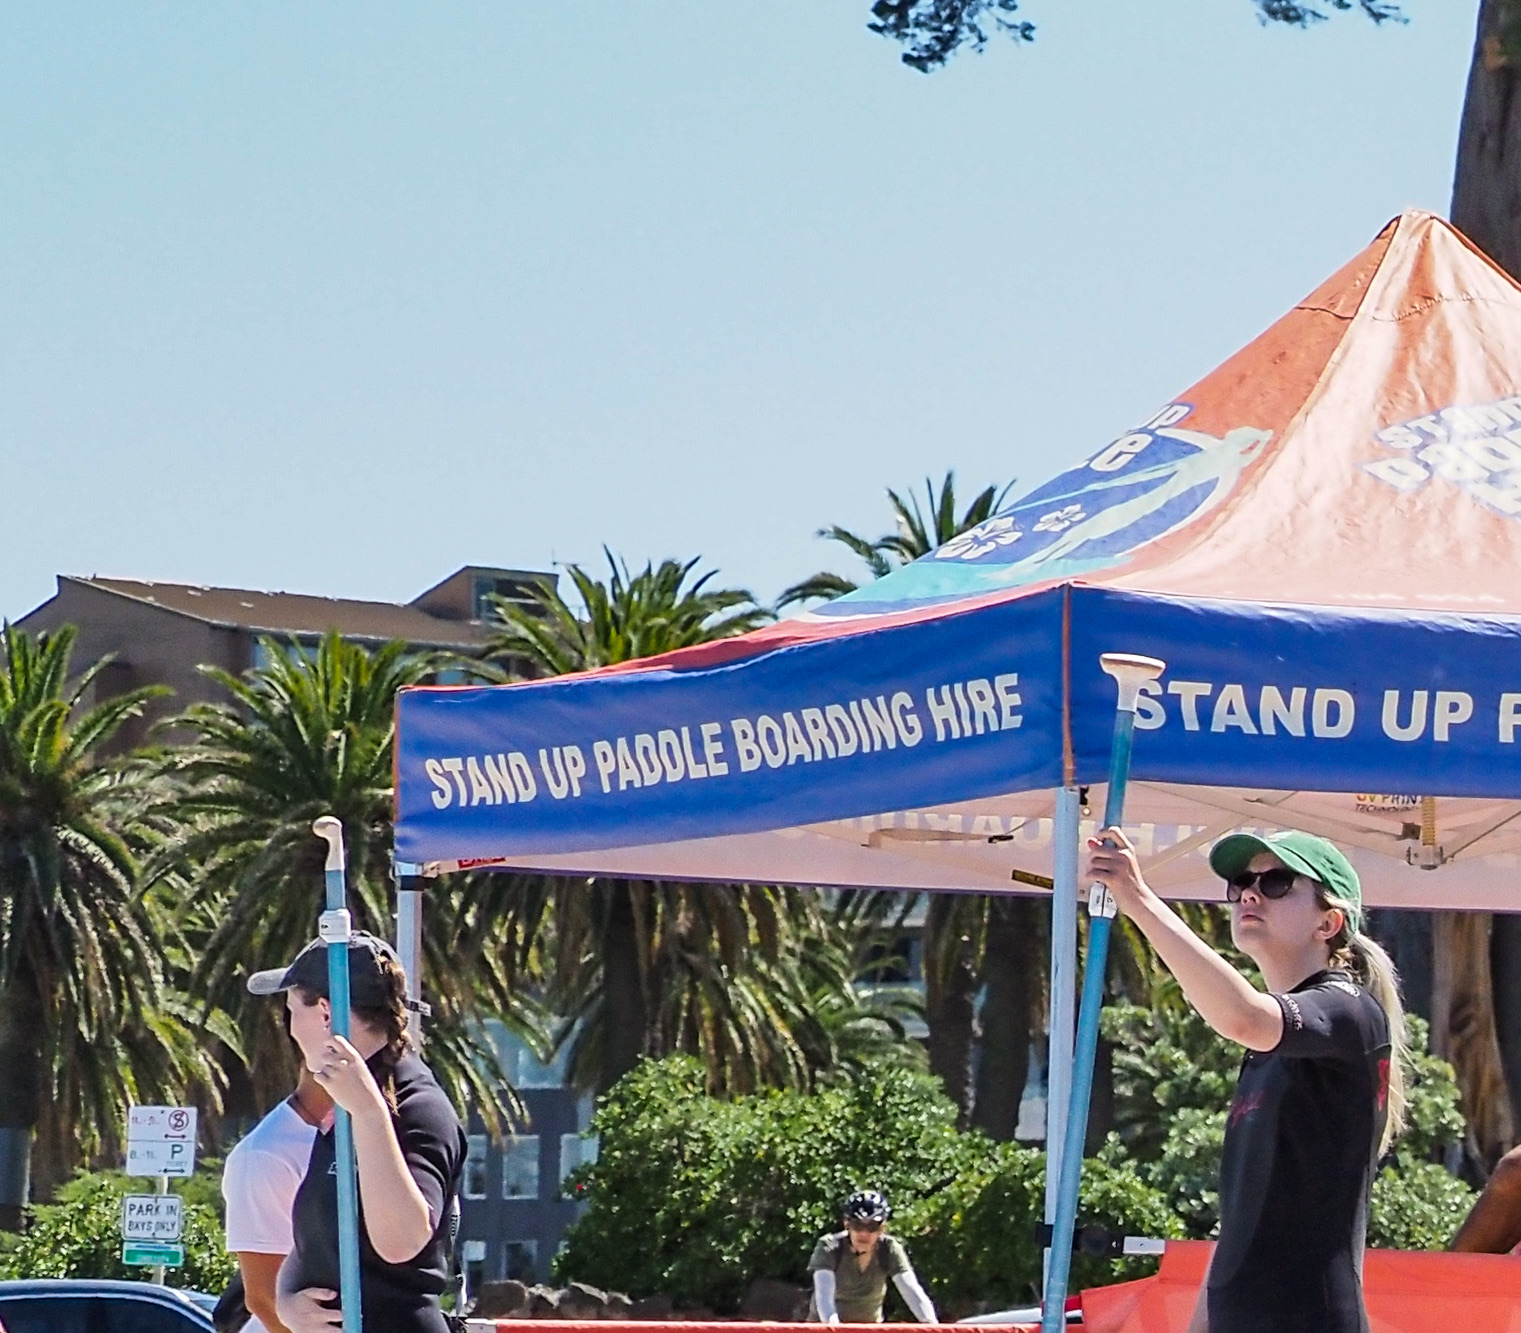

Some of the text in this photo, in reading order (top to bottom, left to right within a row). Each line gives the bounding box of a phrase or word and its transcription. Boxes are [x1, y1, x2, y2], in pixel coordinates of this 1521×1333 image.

[426, 673, 1024, 808] STAND UP PADDLE BOARDING HIRE
[1132, 679, 1355, 739] STAND
[1380, 690, 1475, 743] UP
[128, 1203, 177, 1217] PARK IN
